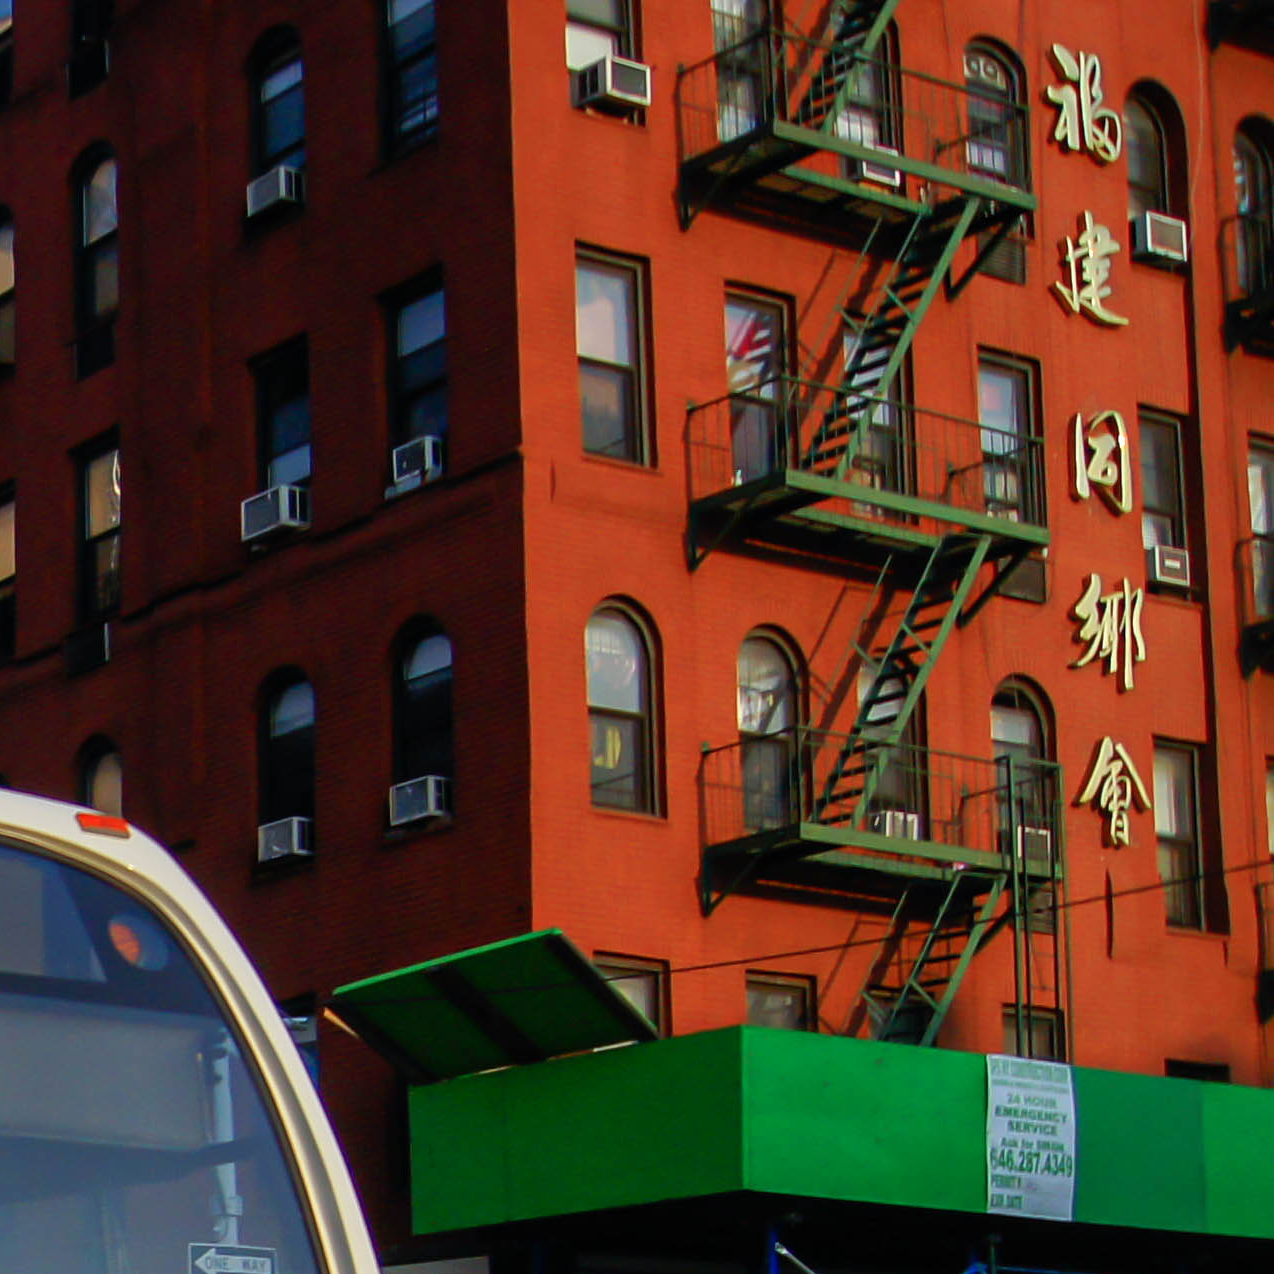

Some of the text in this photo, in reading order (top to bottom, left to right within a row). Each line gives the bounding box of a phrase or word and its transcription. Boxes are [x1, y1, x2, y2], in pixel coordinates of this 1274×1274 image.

[995, 1105, 1068, 1125] EMERGENCY
[1007, 1120, 1059, 1137] SERVICE
[205, 1256, 266, 1272] ONE WAY
